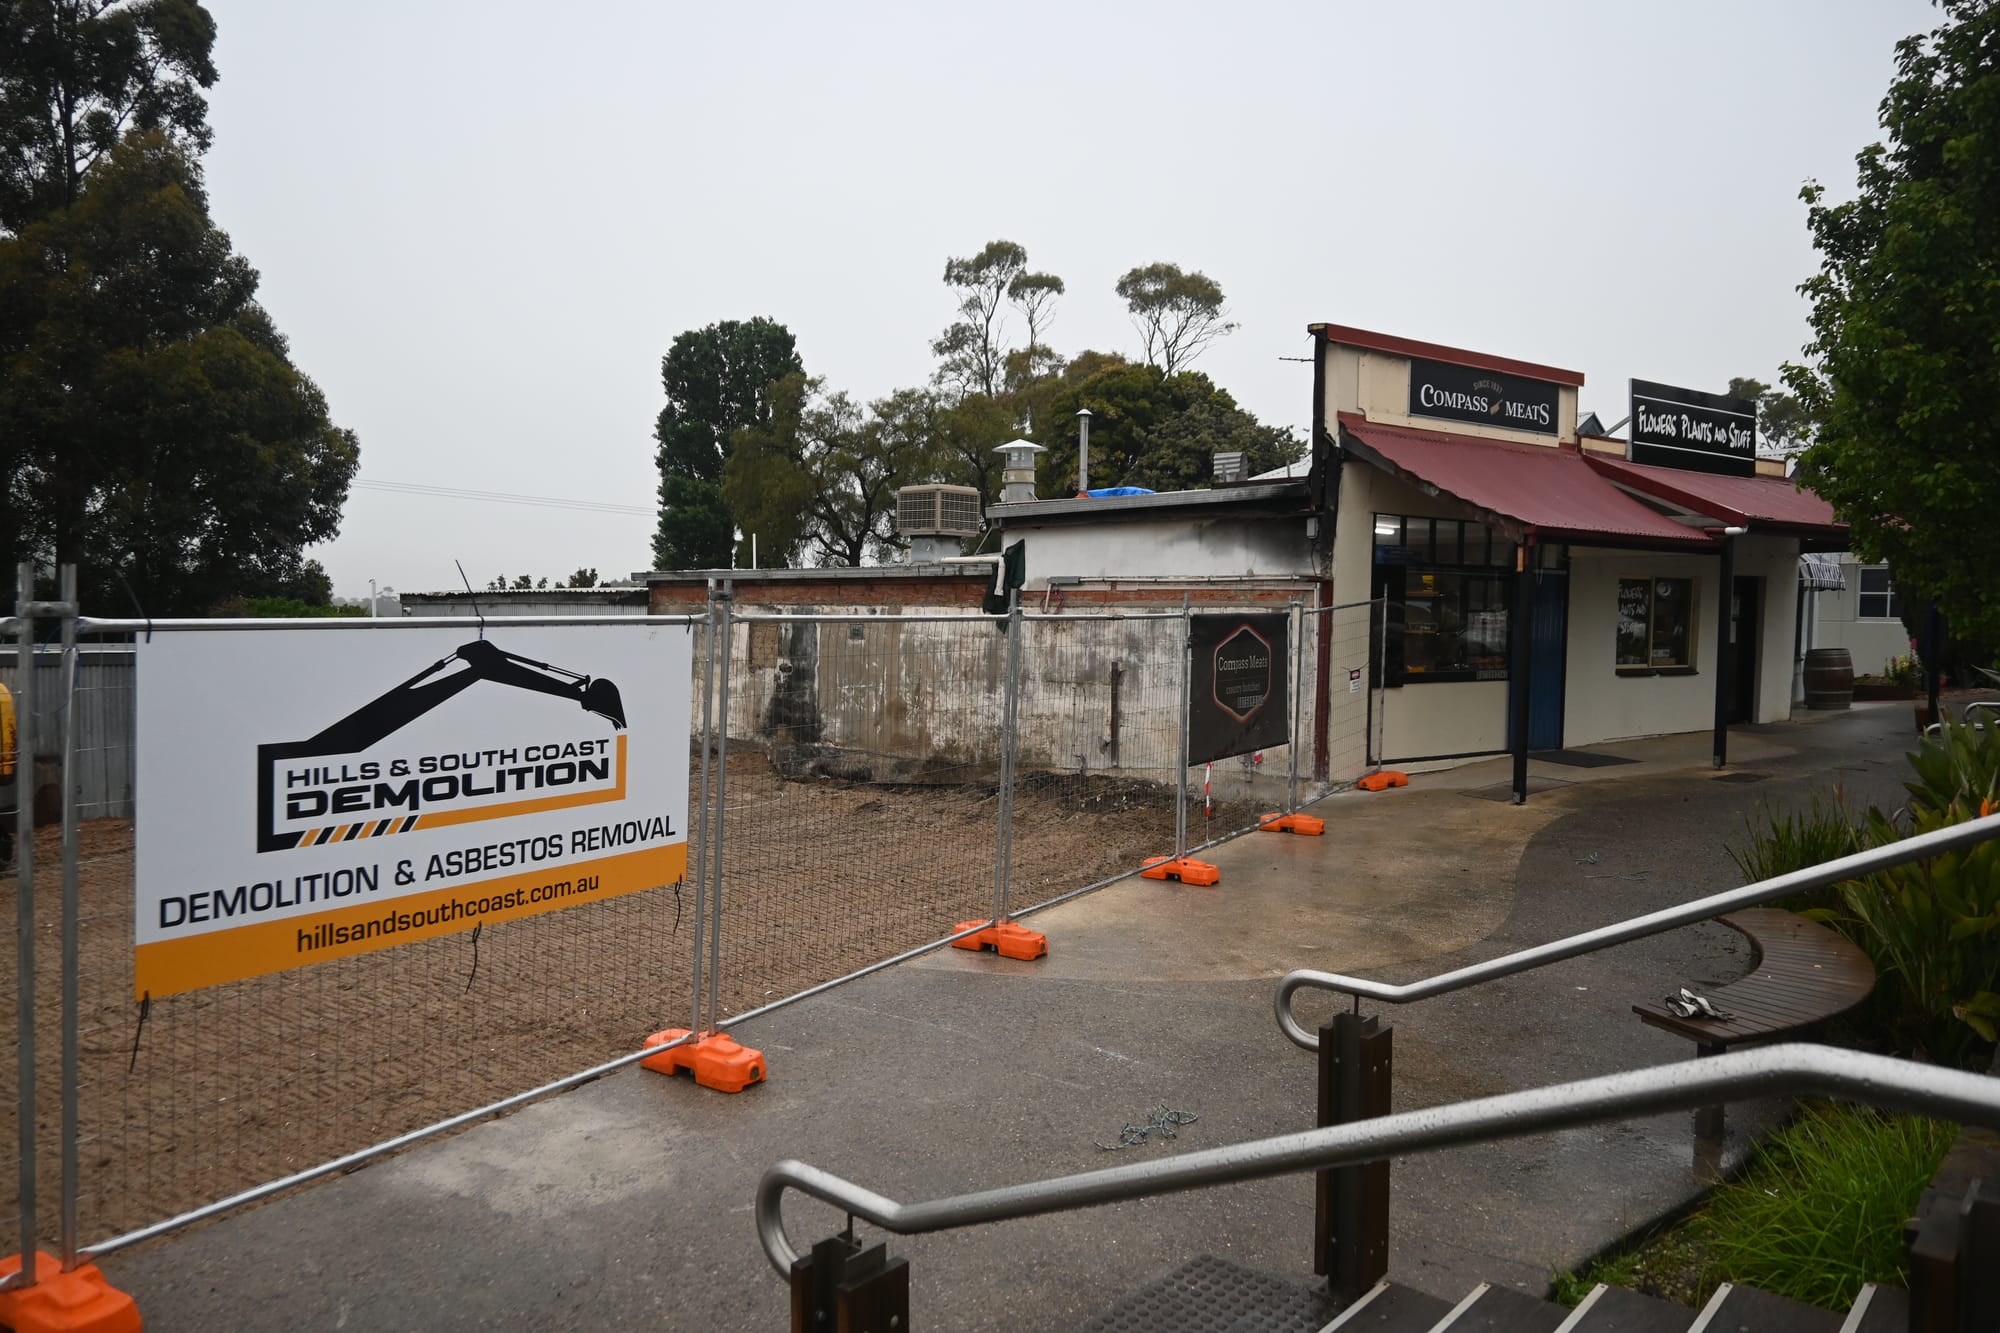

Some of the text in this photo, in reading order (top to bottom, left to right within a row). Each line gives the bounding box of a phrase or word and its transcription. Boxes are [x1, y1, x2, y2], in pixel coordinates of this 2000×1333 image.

[1420, 383, 1550, 425] COMPASS MEATS
[1472, 379, 1490, 391] SINCE
[1638, 404, 1752, 449] FLOWERS PLANTS AND STUFF
[1218, 655, 1268, 674] Compass Meats
[286, 738, 610, 789] HILLS & SOUTH COAST
[286, 757, 610, 821] DEMOLITION
[159, 815, 677, 929] DEMOLITION & ASBESTOS REMOVAL
[296, 874, 600, 953] hillsandsouthcoast.com.au
